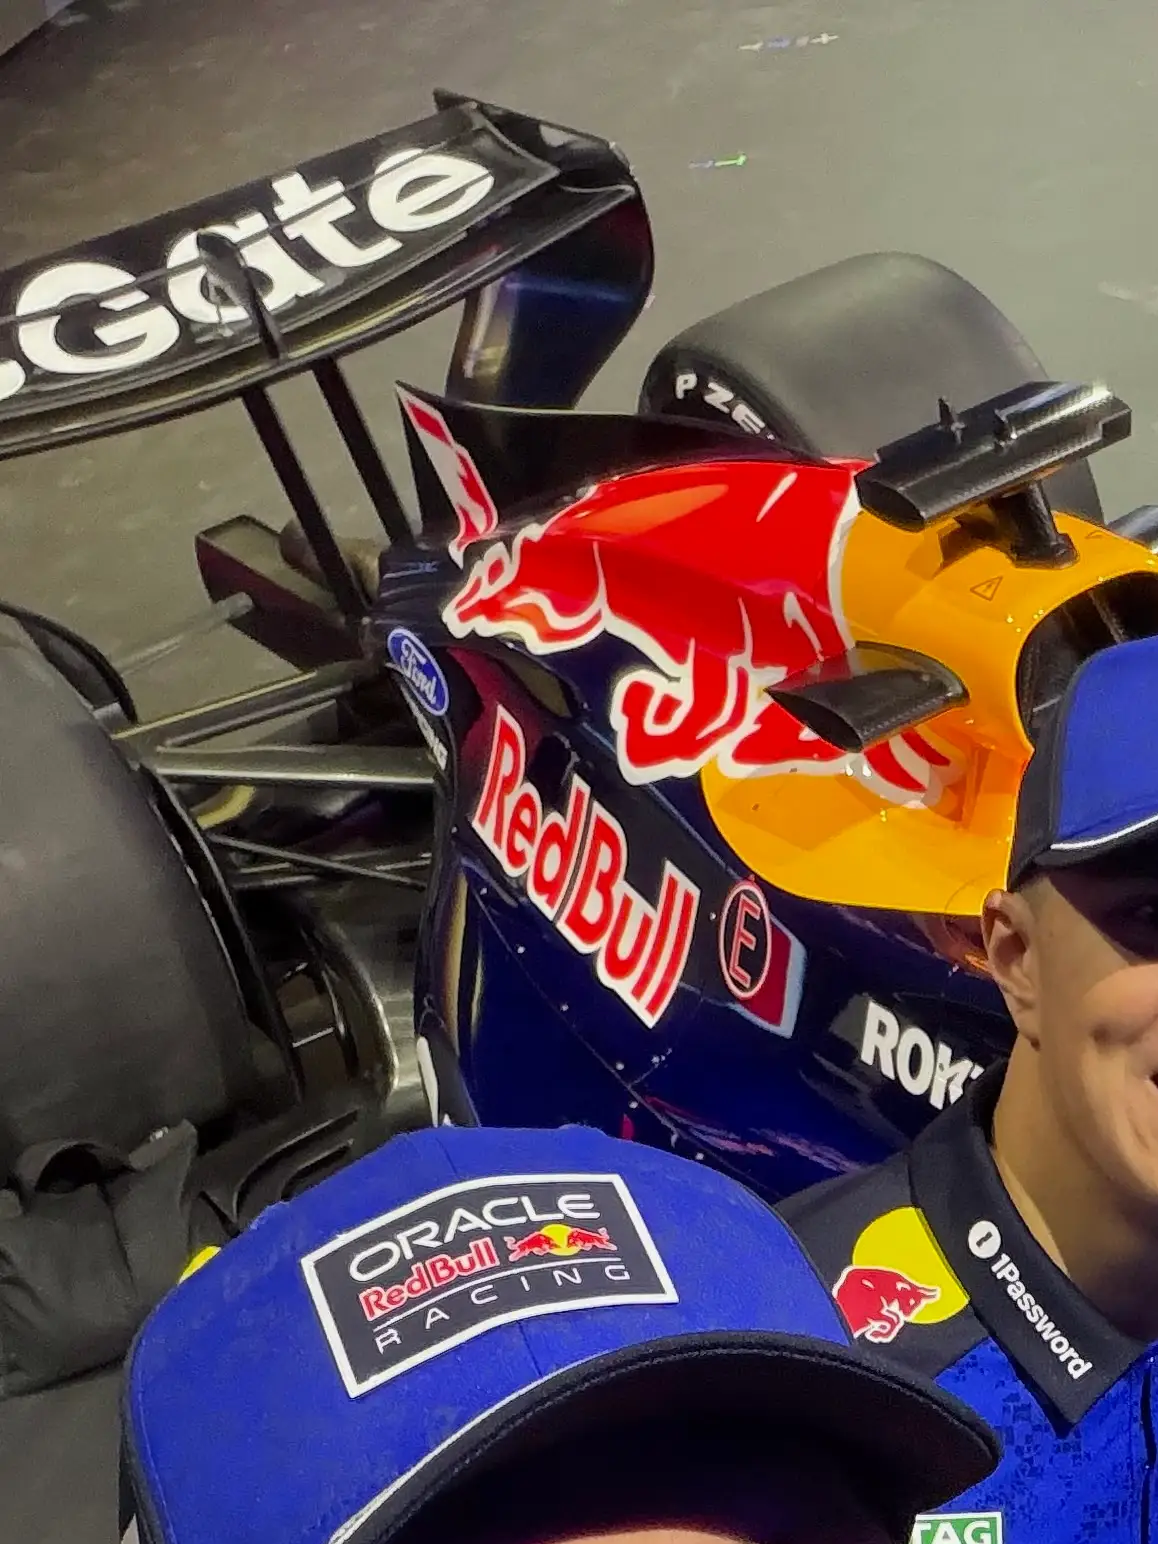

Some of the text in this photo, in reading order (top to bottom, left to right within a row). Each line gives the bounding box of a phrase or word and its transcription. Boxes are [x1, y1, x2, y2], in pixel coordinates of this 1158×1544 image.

[17, 148, 494, 373] Gate
[703, 382, 776, 440] ZE
[861, 1000, 985, 1110] ROK
[349, 1192, 601, 1283] ORACLE
[373, 1263, 631, 1355] RACING
[990, 1253, 1092, 1381] 1Password
